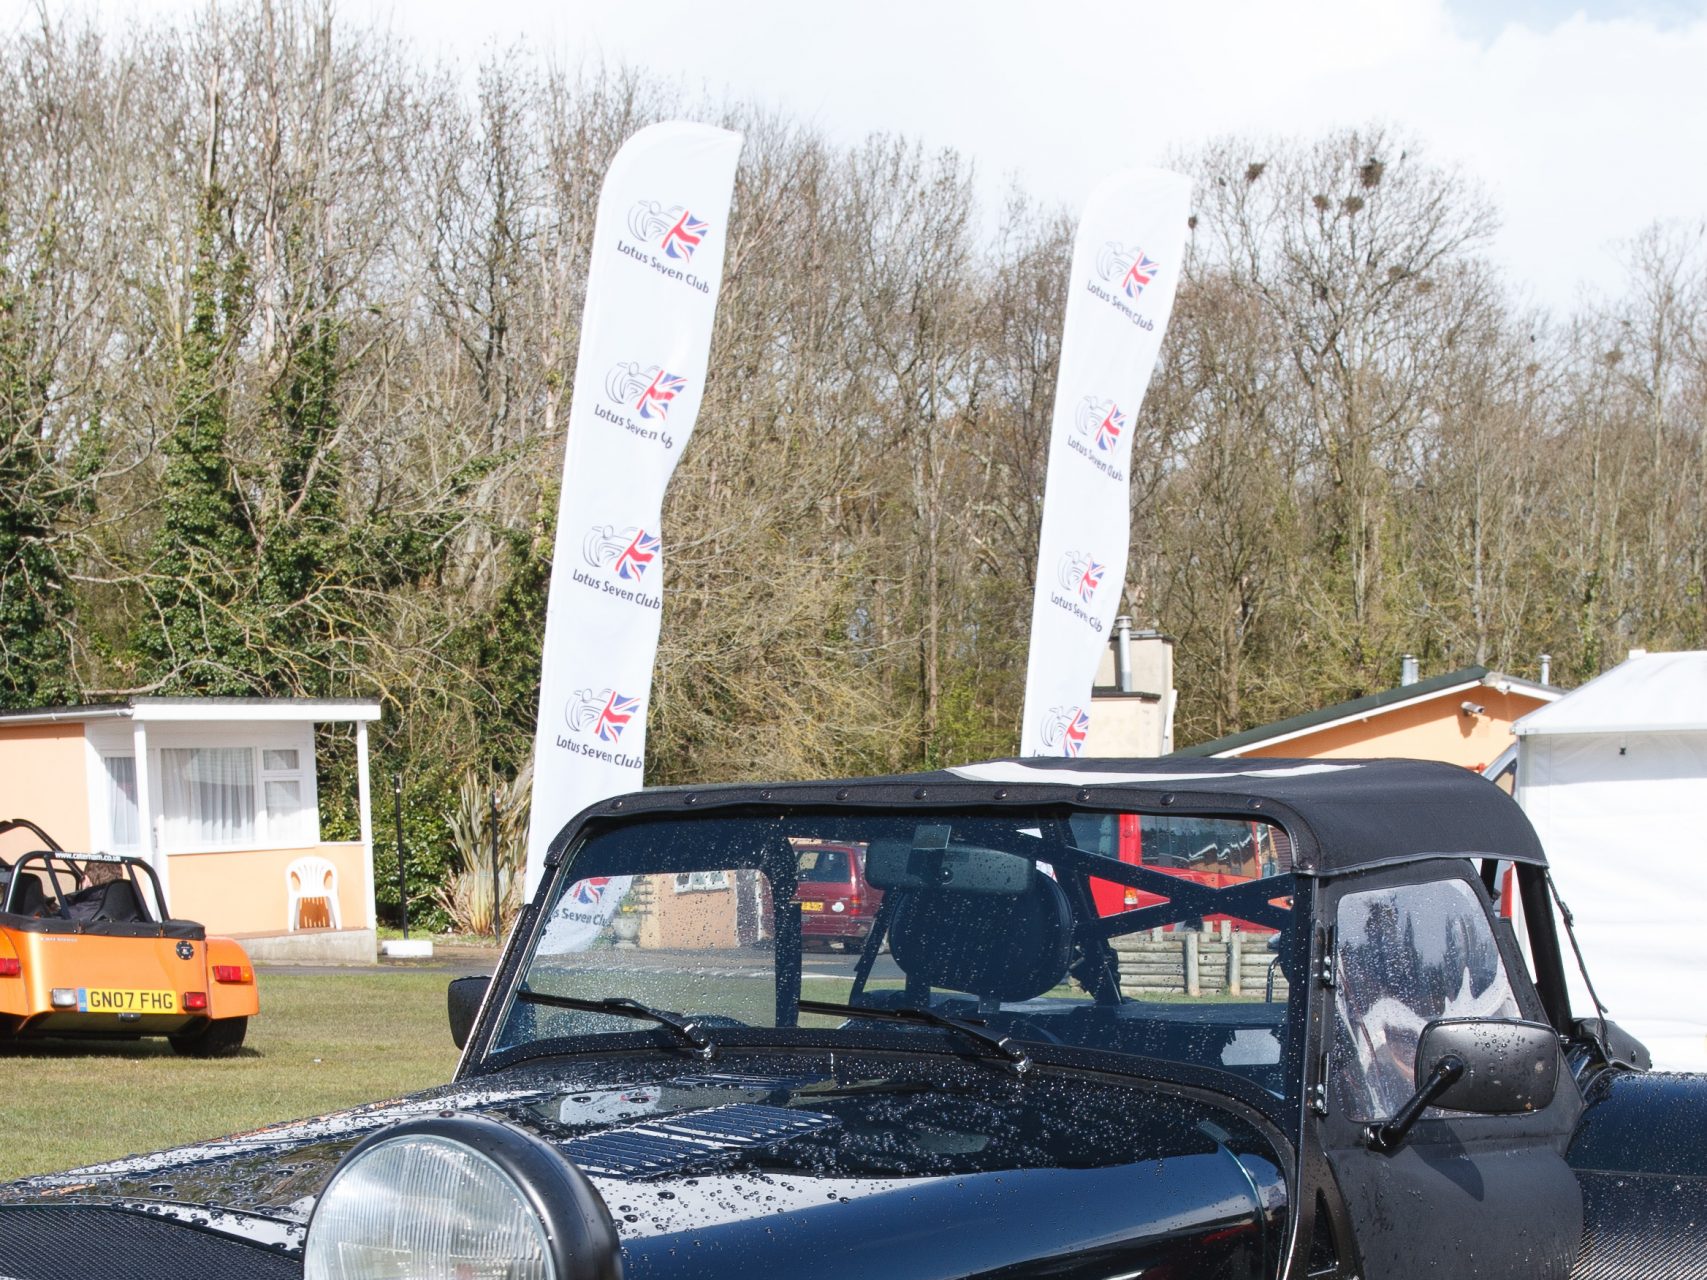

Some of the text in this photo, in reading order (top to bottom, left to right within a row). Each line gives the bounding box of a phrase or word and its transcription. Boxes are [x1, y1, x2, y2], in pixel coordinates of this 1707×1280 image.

[617, 239, 710, 294] Lotus Seven Club
[1087, 279, 1110, 302] Lotus
[1132, 312, 1154, 332] Club
[594, 403, 625, 426] Lotus
[625, 417, 658, 441] Seven
[1067, 434, 1088, 457] Lotus
[572, 568, 661, 610] Lotus Seven Club
[1051, 591, 1073, 612] Lotus
[556, 734, 643, 769] Lotus Seven Club
[54, 852, 121, 862] www.caterham.co.uk
[562, 907, 592, 925] Seven
[90, 991, 173, 1010] GN07 FHG
